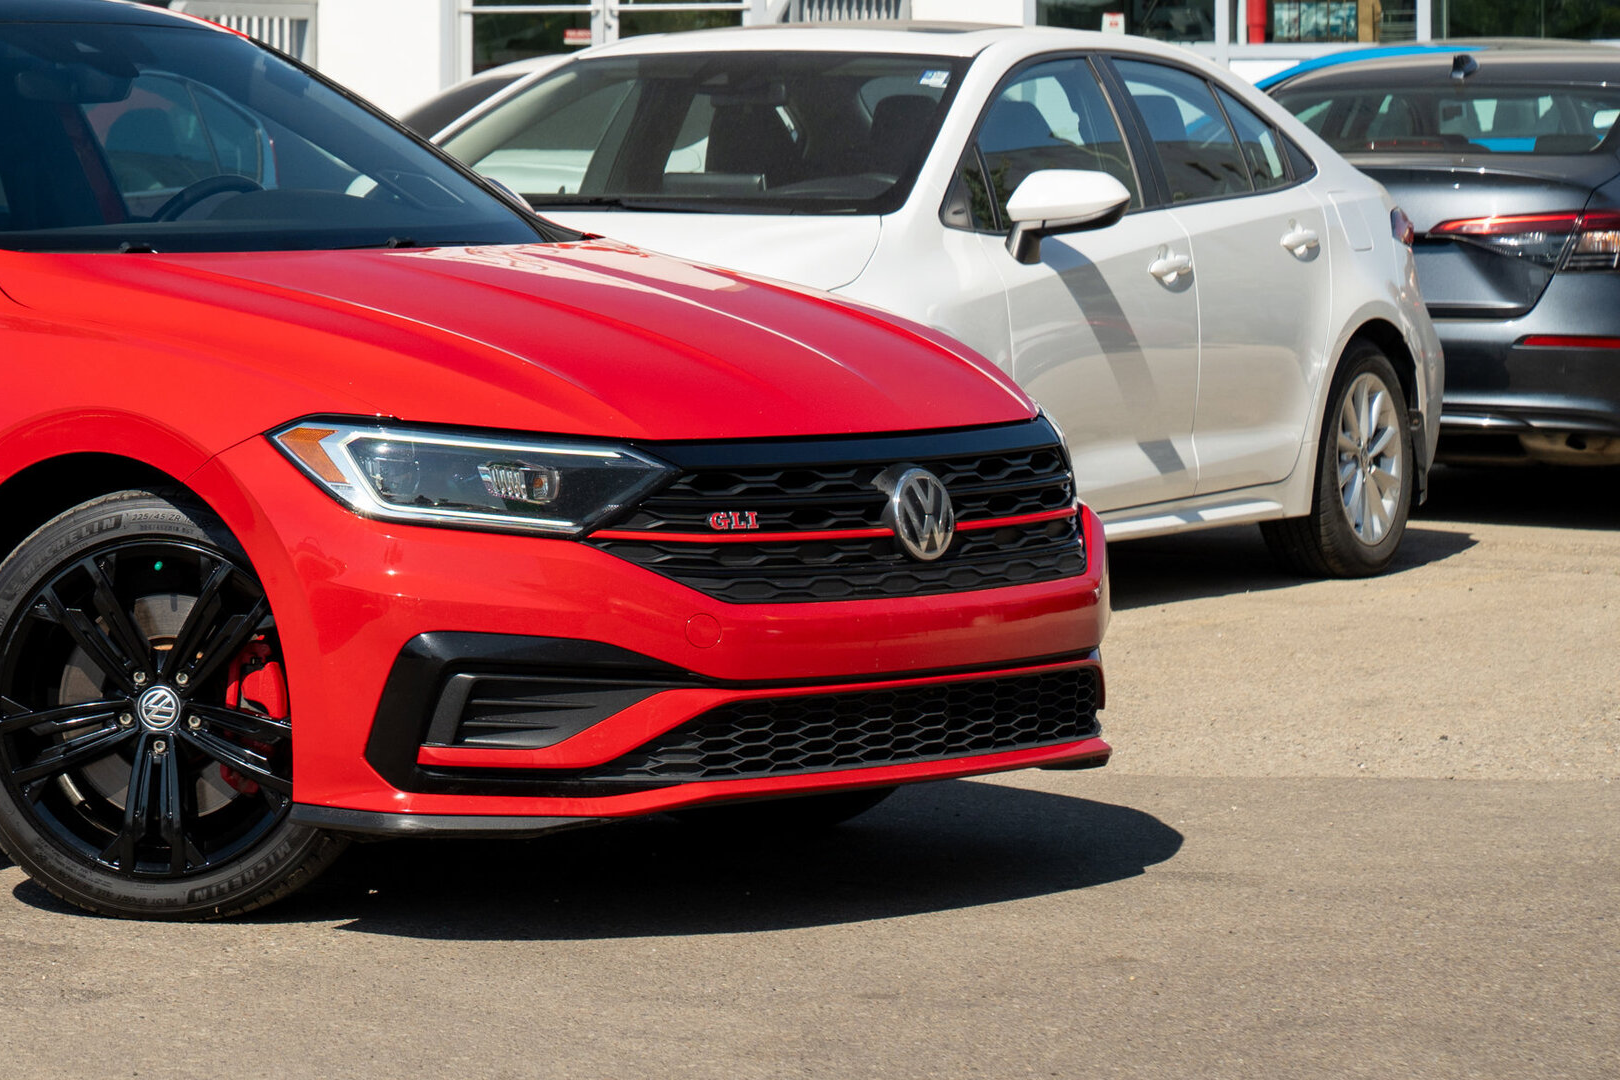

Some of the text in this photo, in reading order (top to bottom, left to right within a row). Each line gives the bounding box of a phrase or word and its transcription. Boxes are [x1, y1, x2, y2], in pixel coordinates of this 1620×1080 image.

[23, 515, 117, 580] MICHELIN
[709, 511, 759, 530] GLI
[194, 837, 292, 903] MICHELIN
